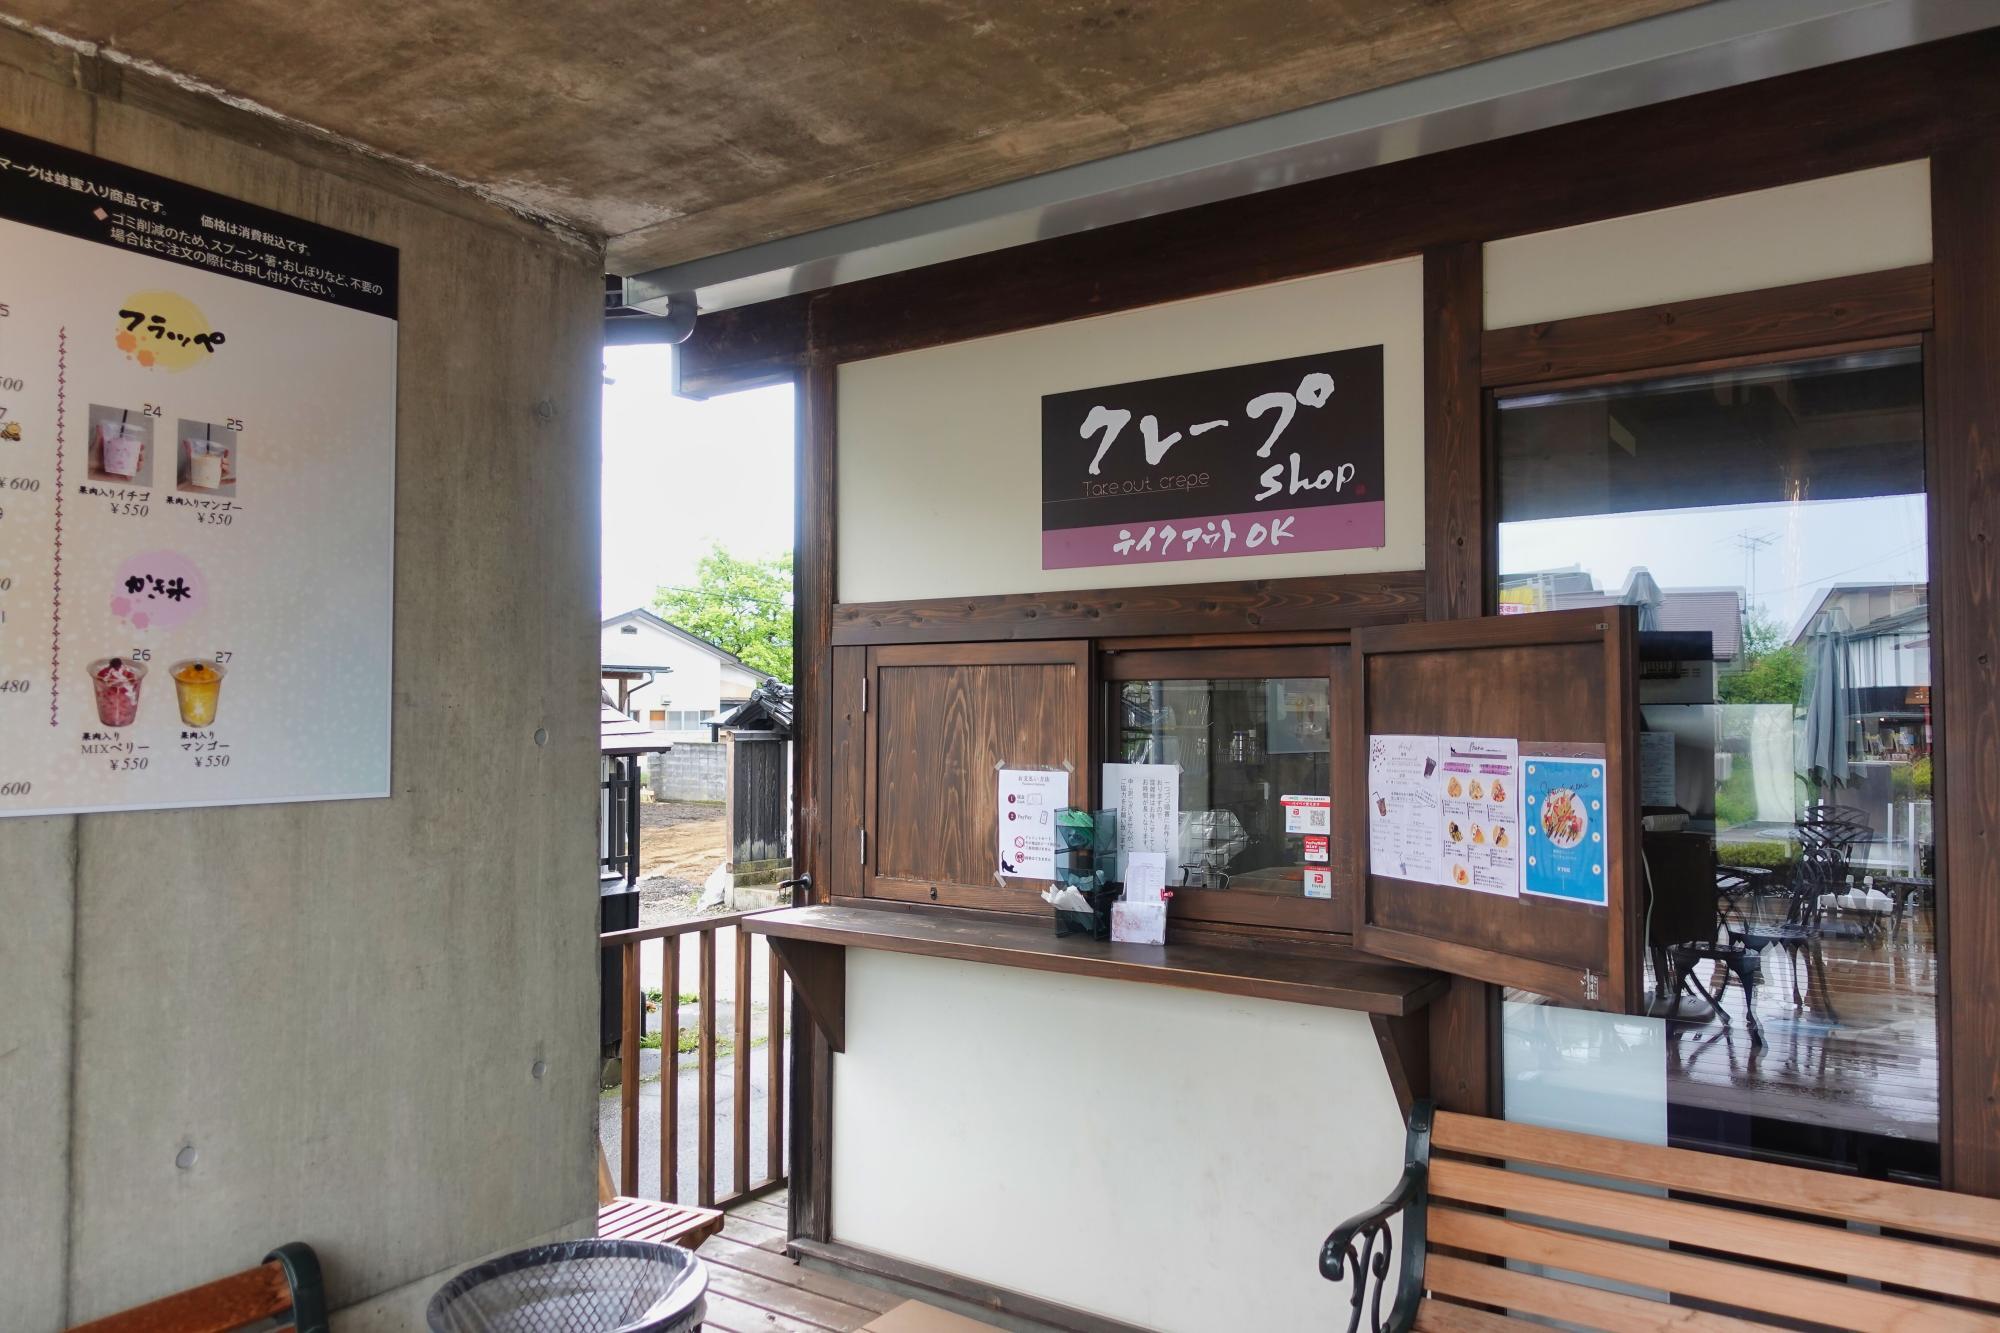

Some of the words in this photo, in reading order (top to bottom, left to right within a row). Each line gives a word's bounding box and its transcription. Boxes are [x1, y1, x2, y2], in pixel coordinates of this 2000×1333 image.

[200, 214, 312, 257] 価格は消費税込です。
[119, 309, 226, 353] フラッペ
[0, 376, 24, 392] 00
[143, 403, 162, 418] 24
[226, 418, 244, 432] 25
[1079, 372, 1336, 476] クレープ
[1122, 475, 1153, 494] out
[1159, 472, 1211, 493] crepe
[110, 502, 150, 518] ¥550
[197, 512, 233, 527] ¥550
[1112, 518, 1237, 556] テイクアウト
[1245, 515, 1296, 548] OK
[124, 573, 192, 602] かき氷
[132, 648, 152, 662] 26
[215, 651, 233, 664] 27
[80, 743, 150, 755] MIXベリー
[180, 740, 231, 752] マンゴー
[109, 757, 149, 771] ¥550
[194, 754, 231, 768] ¥550
